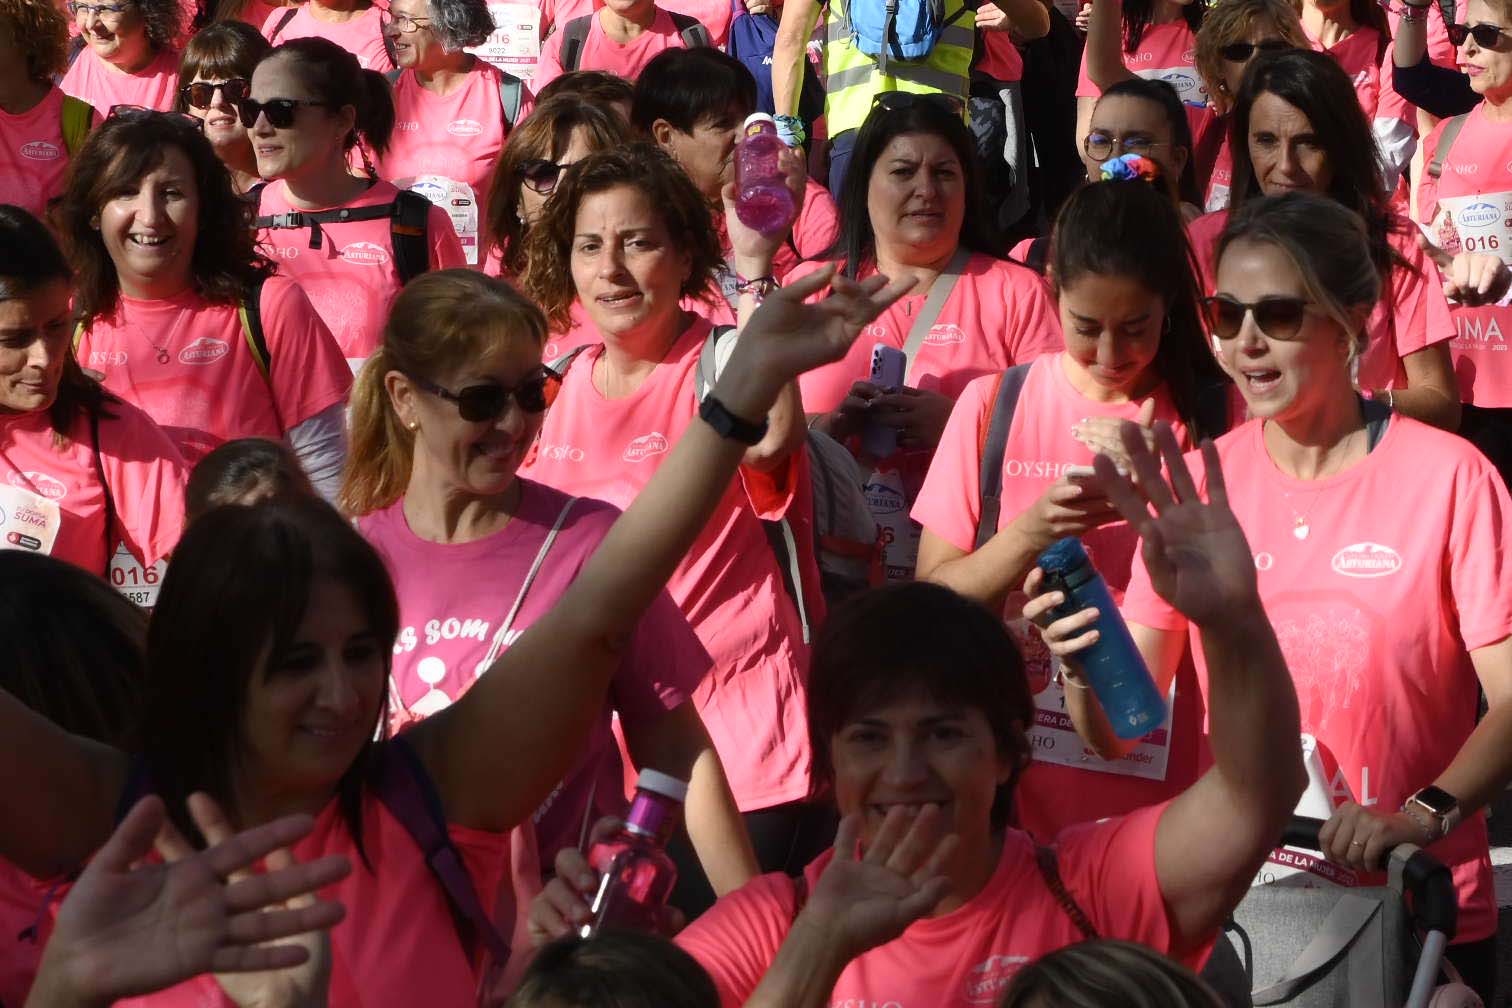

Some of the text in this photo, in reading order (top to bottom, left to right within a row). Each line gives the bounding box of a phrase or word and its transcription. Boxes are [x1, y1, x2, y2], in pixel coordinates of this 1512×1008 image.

[1465, 235, 1499, 252] 016
[14, 512, 47, 529] SUMA
[1339, 556, 1396, 569] ASTURIANA
[112, 566, 158, 586] 016
[1037, 714, 1057, 726] ERA
[1278, 854, 1292, 864] DE
[1294, 855, 1308, 867] LA
